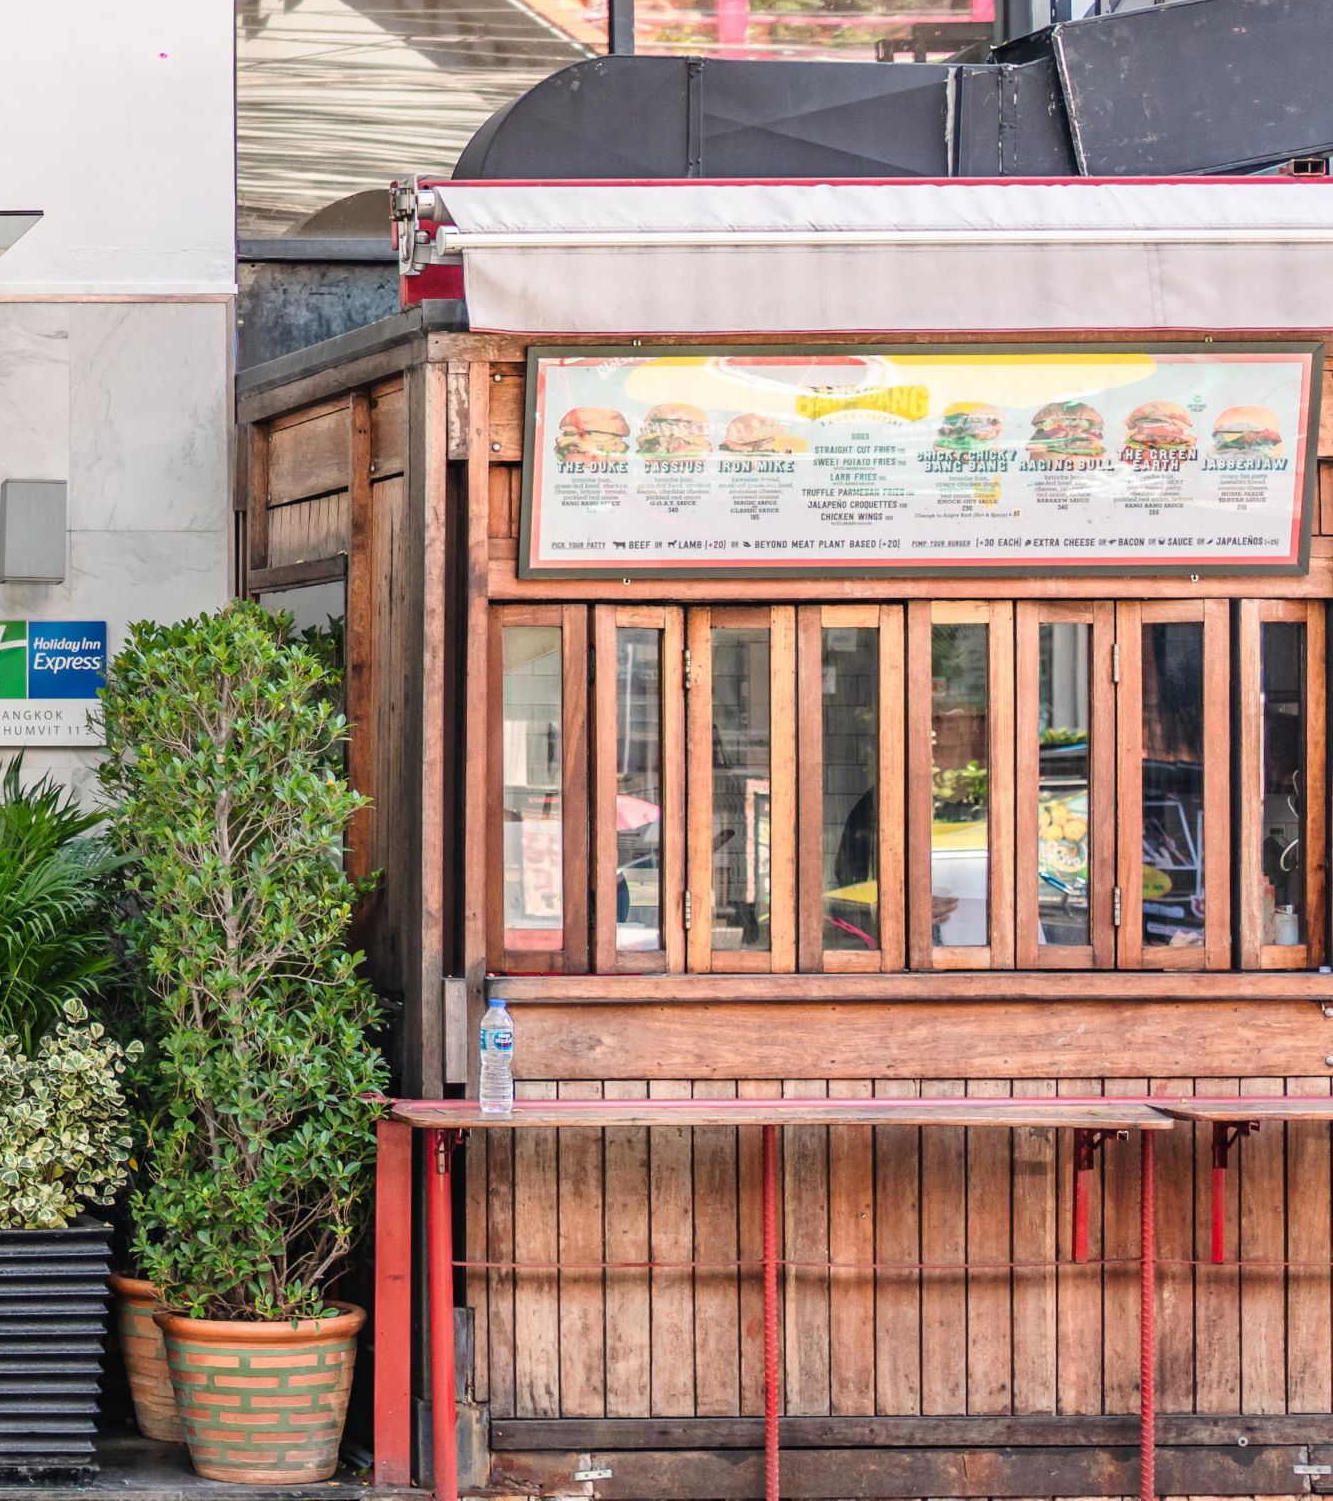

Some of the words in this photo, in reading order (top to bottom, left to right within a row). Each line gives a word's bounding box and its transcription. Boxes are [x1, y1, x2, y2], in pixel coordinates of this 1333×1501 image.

[815, 446, 853, 454] STRAIGHT
[857, 446, 871, 454] CUT
[874, 446, 896, 454] FRIES
[1117, 449, 1143, 461] THE
[1150, 449, 1197, 461] GREEN
[557, 461, 583, 474] THE
[587, 461, 627, 474] DUKE
[644, 461, 704, 474] CASSIUS
[718, 460, 752, 473] IRON
[757, 460, 795, 473] MIKE
[813, 458, 839, 466] SWEET
[843, 458, 871, 466] POTATO
[873, 458, 896, 466] FRIES
[925, 460, 963, 472] BANG
[970, 460, 1007, 472] BANG
[1019, 460, 1074, 472] RAGING
[1079, 460, 1115, 472] BULL
[1133, 460, 1179, 472] EARTH
[1202, 458, 1287, 470] JABBERJAW
[850, 501, 898, 509] CROQUETTES
[629, 541, 651, 549] BEEF
[679, 541, 702, 549] LAMB
[755, 541, 788, 549] BEYOND
[791, 540, 815, 549] MEAT
[818, 540, 845, 549] PLANT
[849, 540, 876, 549] BASED
[1033, 538, 1060, 547] EXTRA
[1064, 538, 1095, 547] CHEESE
[1118, 538, 1145, 546] BACON
[1167, 538, 1193, 546] SAUCE
[33, 637, 80, 652] Holiday
[81, 638, 101, 650] Inn
[33, 653, 101, 674] Express
[68, 726, 80, 736] 11
